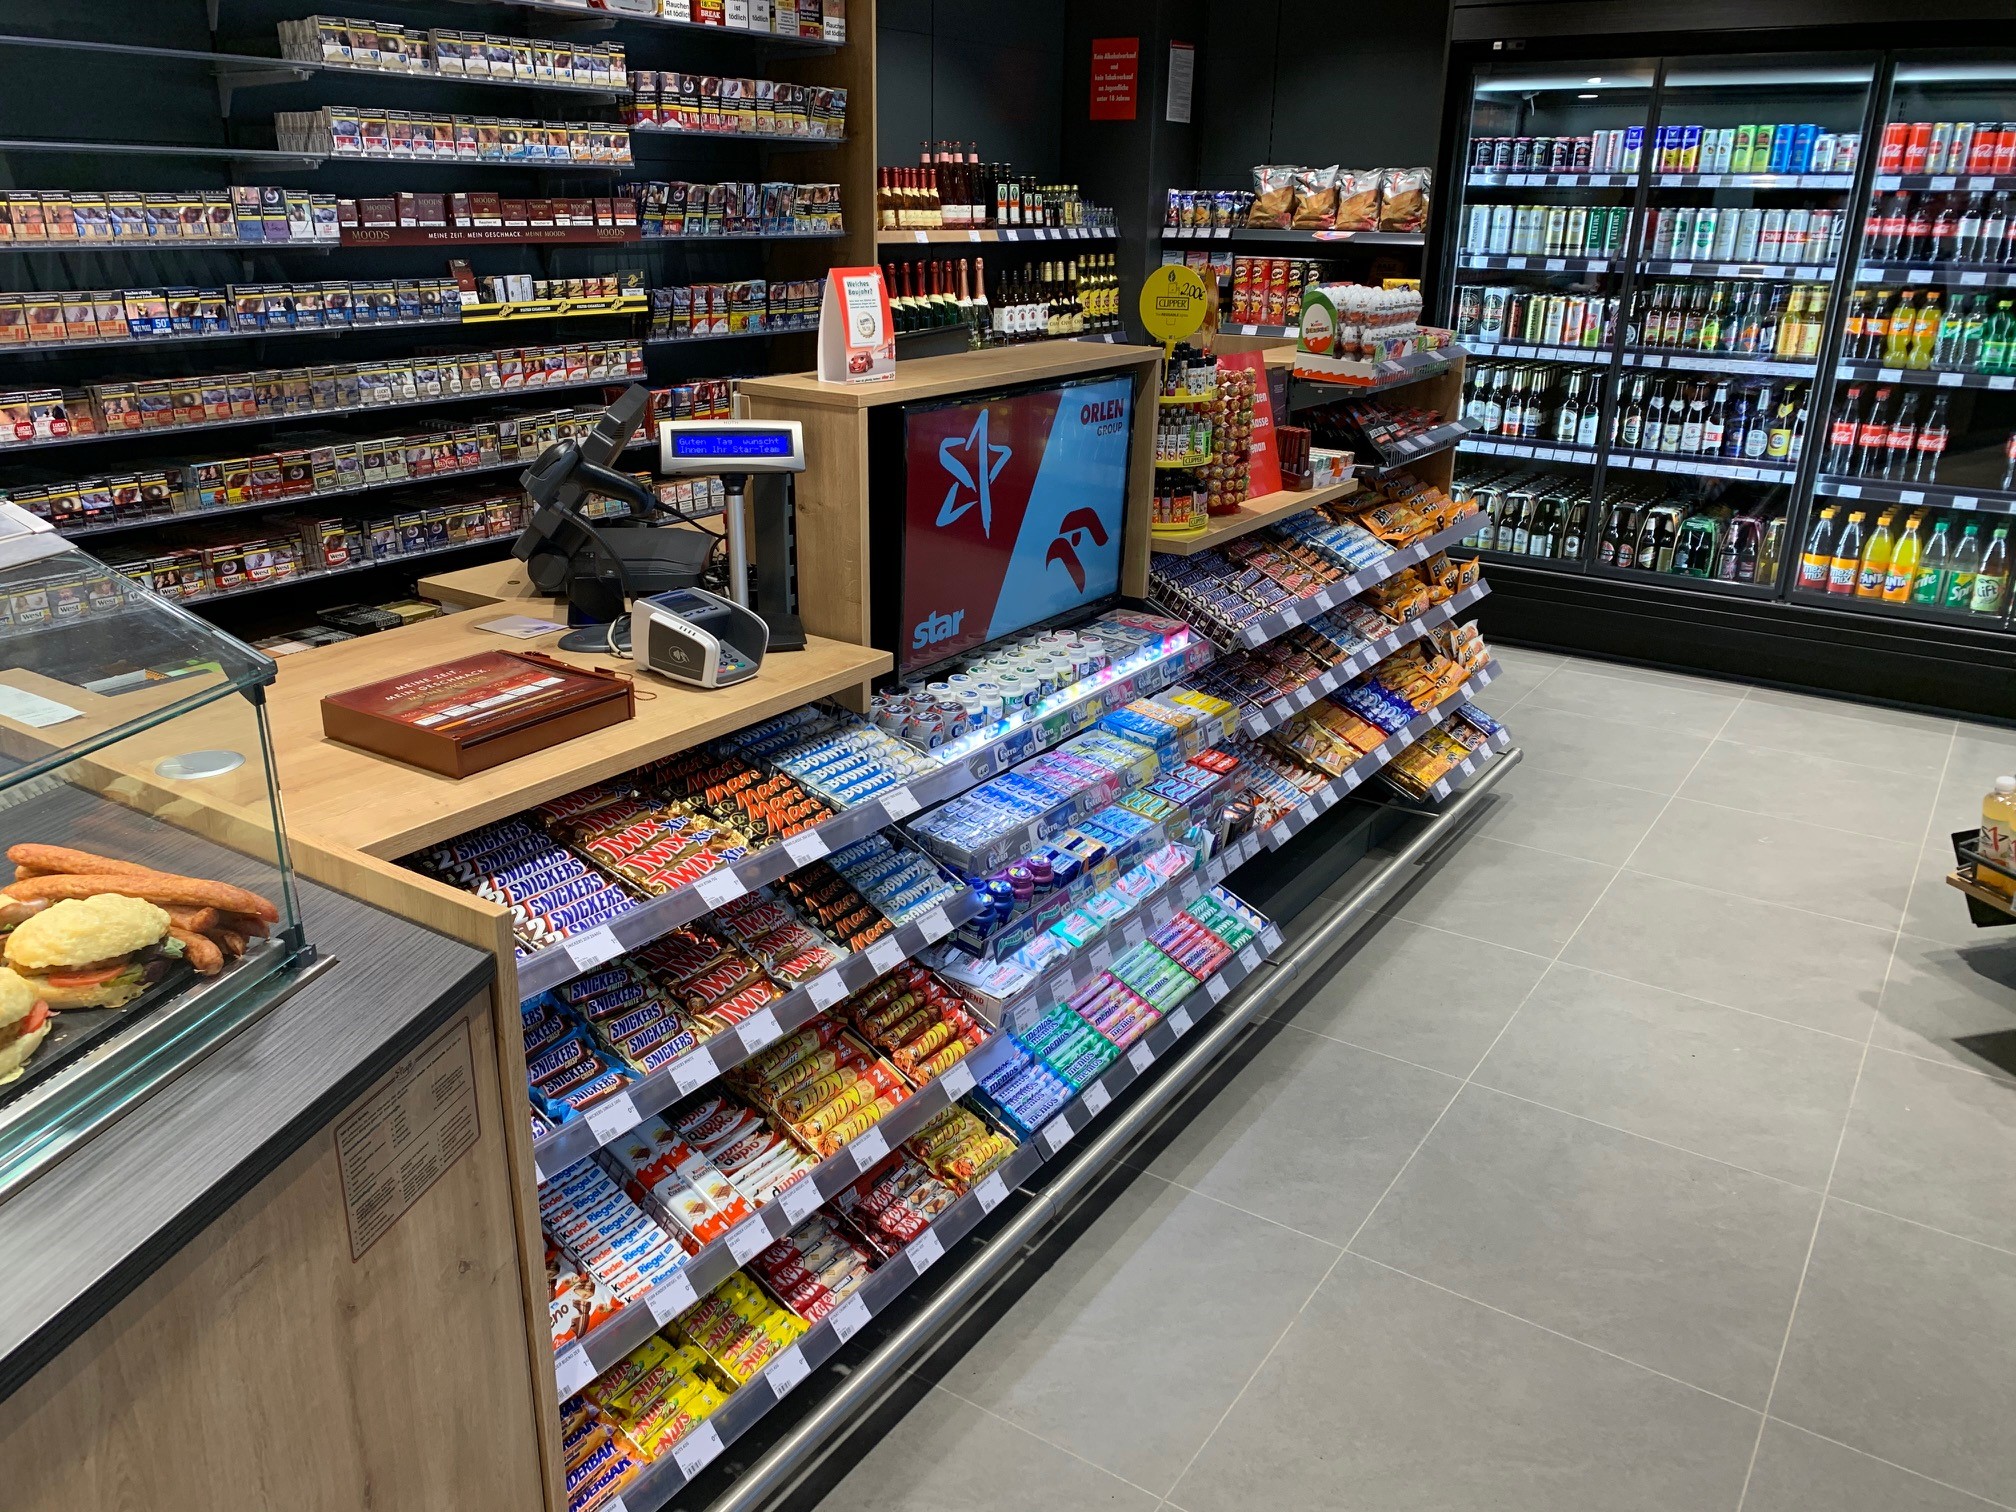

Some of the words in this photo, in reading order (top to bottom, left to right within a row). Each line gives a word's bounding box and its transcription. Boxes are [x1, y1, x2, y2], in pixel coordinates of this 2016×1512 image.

[700, 9, 721, 19] BREAK
[728, 12, 747, 22] tödlich
[733, 3, 741, 12] ist
[751, 13, 769, 24] tödlich
[352, 230, 391, 241] MOODS
[597, 228, 625, 237] MOODS
[1588, 214, 1600, 241] VELTINS
[1609, 213, 1620, 241] VELTINS
[847, 280, 870, 288] Welches
[848, 288, 873, 297] Baujahr?
[1158, 299, 1187, 308] CLIPPER
[1079, 398, 1125, 425] ORLEN
[679, 437, 707, 445] Guten
[1096, 421, 1123, 437] GROUP
[680, 446, 707, 454] Ihnen
[712, 445, 728, 453] Ihr
[732, 445, 780, 453] Star-Team
[329, 551, 346, 559] West
[183, 581, 199, 591] West
[223, 574, 240, 583] West
[252, 568, 270, 577] West
[160, 586, 180, 595] West
[59, 604, 79, 613] West
[911, 608, 965, 650] star
[384, 688, 416, 702] MEIN
[418, 668, 492, 691] GESCHMACK.
[394, 677, 432, 691] MEINE
[433, 668, 463, 680] ZEIT.
[797, 740, 851, 772] BOUNTY
[814, 750, 869, 779] BOUNTY
[687, 755, 745, 794] Mars
[704, 767, 763, 806] Mars
[826, 760, 883, 789] BOUNTY
[838, 770, 896, 799] BOUNTY
[734, 771, 792, 811] Mars
[747, 785, 806, 821] Mars
[765, 796, 822, 835] Mars
[586, 818, 663, 862] TWIX
[616, 832, 691, 876] TWIX
[830, 836, 876, 870] BOUNTY
[508, 857, 585, 903] SNICKERS
[648, 847, 721, 890] TWIX
[529, 871, 605, 918] SNICKERS
[888, 878, 933, 912] BOUNTY
[526, 918, 548, 941] 2
[550, 884, 628, 931] SNICKERS
[1213, 919, 1234, 934] VIVIL
[850, 917, 894, 954] Mars
[1232, 932, 1252, 948] VIVIL
[771, 945, 829, 978] TWIX
[572, 968, 628, 1000] SNICKERS
[679, 957, 751, 1004] TWIX
[957, 984, 985, 1005] FRIEND
[1145, 976, 1169, 998] mentos
[588, 982, 644, 1017] SNICKERS
[705, 980, 773, 1025] TWIX
[610, 1001, 662, 1039] SNICKERS
[1094, 1002, 1120, 1026] mentos
[1109, 1014, 1136, 1038] mentos
[628, 1014, 679, 1054] SNICKERS
[1042, 1030, 1071, 1057] mentos
[872, 1069, 885, 1081] 2
[1067, 1050, 1096, 1077] mentos
[1075, 1057, 1103, 1084] mentos
[891, 1086, 903, 1102] 2
[1027, 1097, 1059, 1125] mentos
[562, 1173, 591, 1198] Riegel
[573, 1185, 601, 1211] Riegel
[587, 1199, 616, 1224] Riegel
[598, 1213, 627, 1237] Riegel
[586, 1246, 613, 1268] kinder
[610, 1227, 640, 1251] Riegel
[598, 1259, 625, 1280] kinder
[622, 1238, 651, 1263] Riegel
[611, 1271, 640, 1293] kinder
[637, 1249, 667, 1275] Riegel
[773, 1256, 806, 1288] KitKat
[549, 1303, 569, 1328] eno
[807, 1290, 836, 1323] KitKat
[705, 1311, 740, 1350] Nuts
[737, 1337, 773, 1376] Nuts
[629, 1365, 667, 1409] Nuts
[653, 1411, 692, 1455] Nuts
